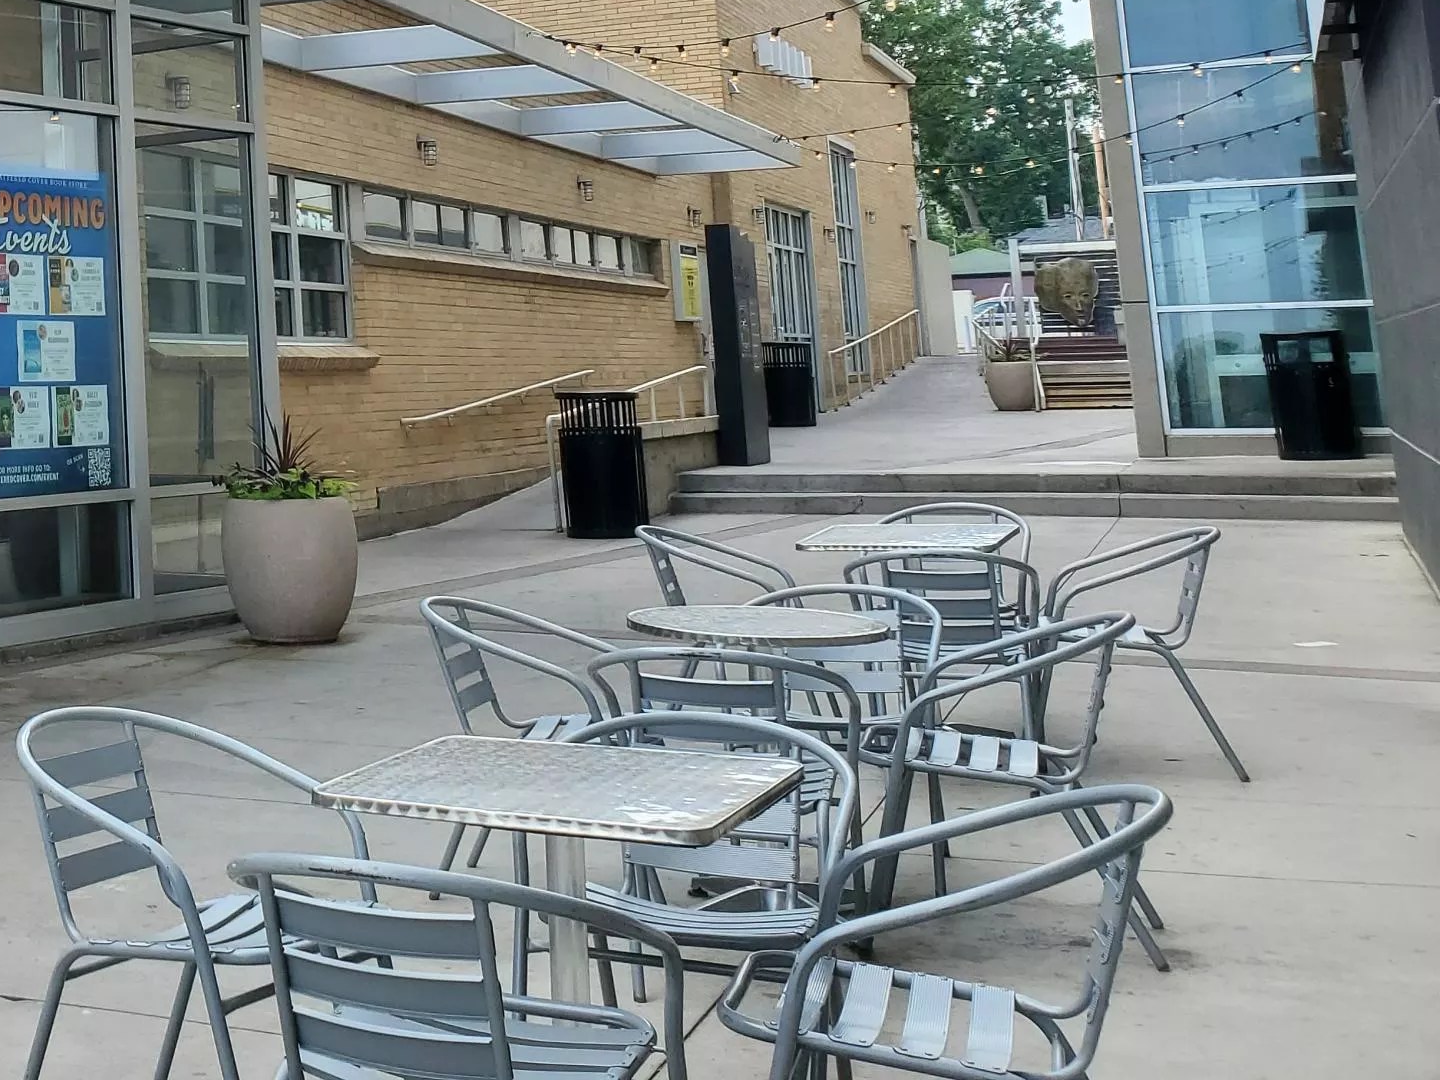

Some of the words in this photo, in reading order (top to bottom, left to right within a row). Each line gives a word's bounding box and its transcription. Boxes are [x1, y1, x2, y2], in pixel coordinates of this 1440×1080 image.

[27, 176, 48, 185] COVER
[49, 179, 66, 187] BOOK
[6, 466, 20, 474] MORE
[22, 465, 34, 473] INFO
